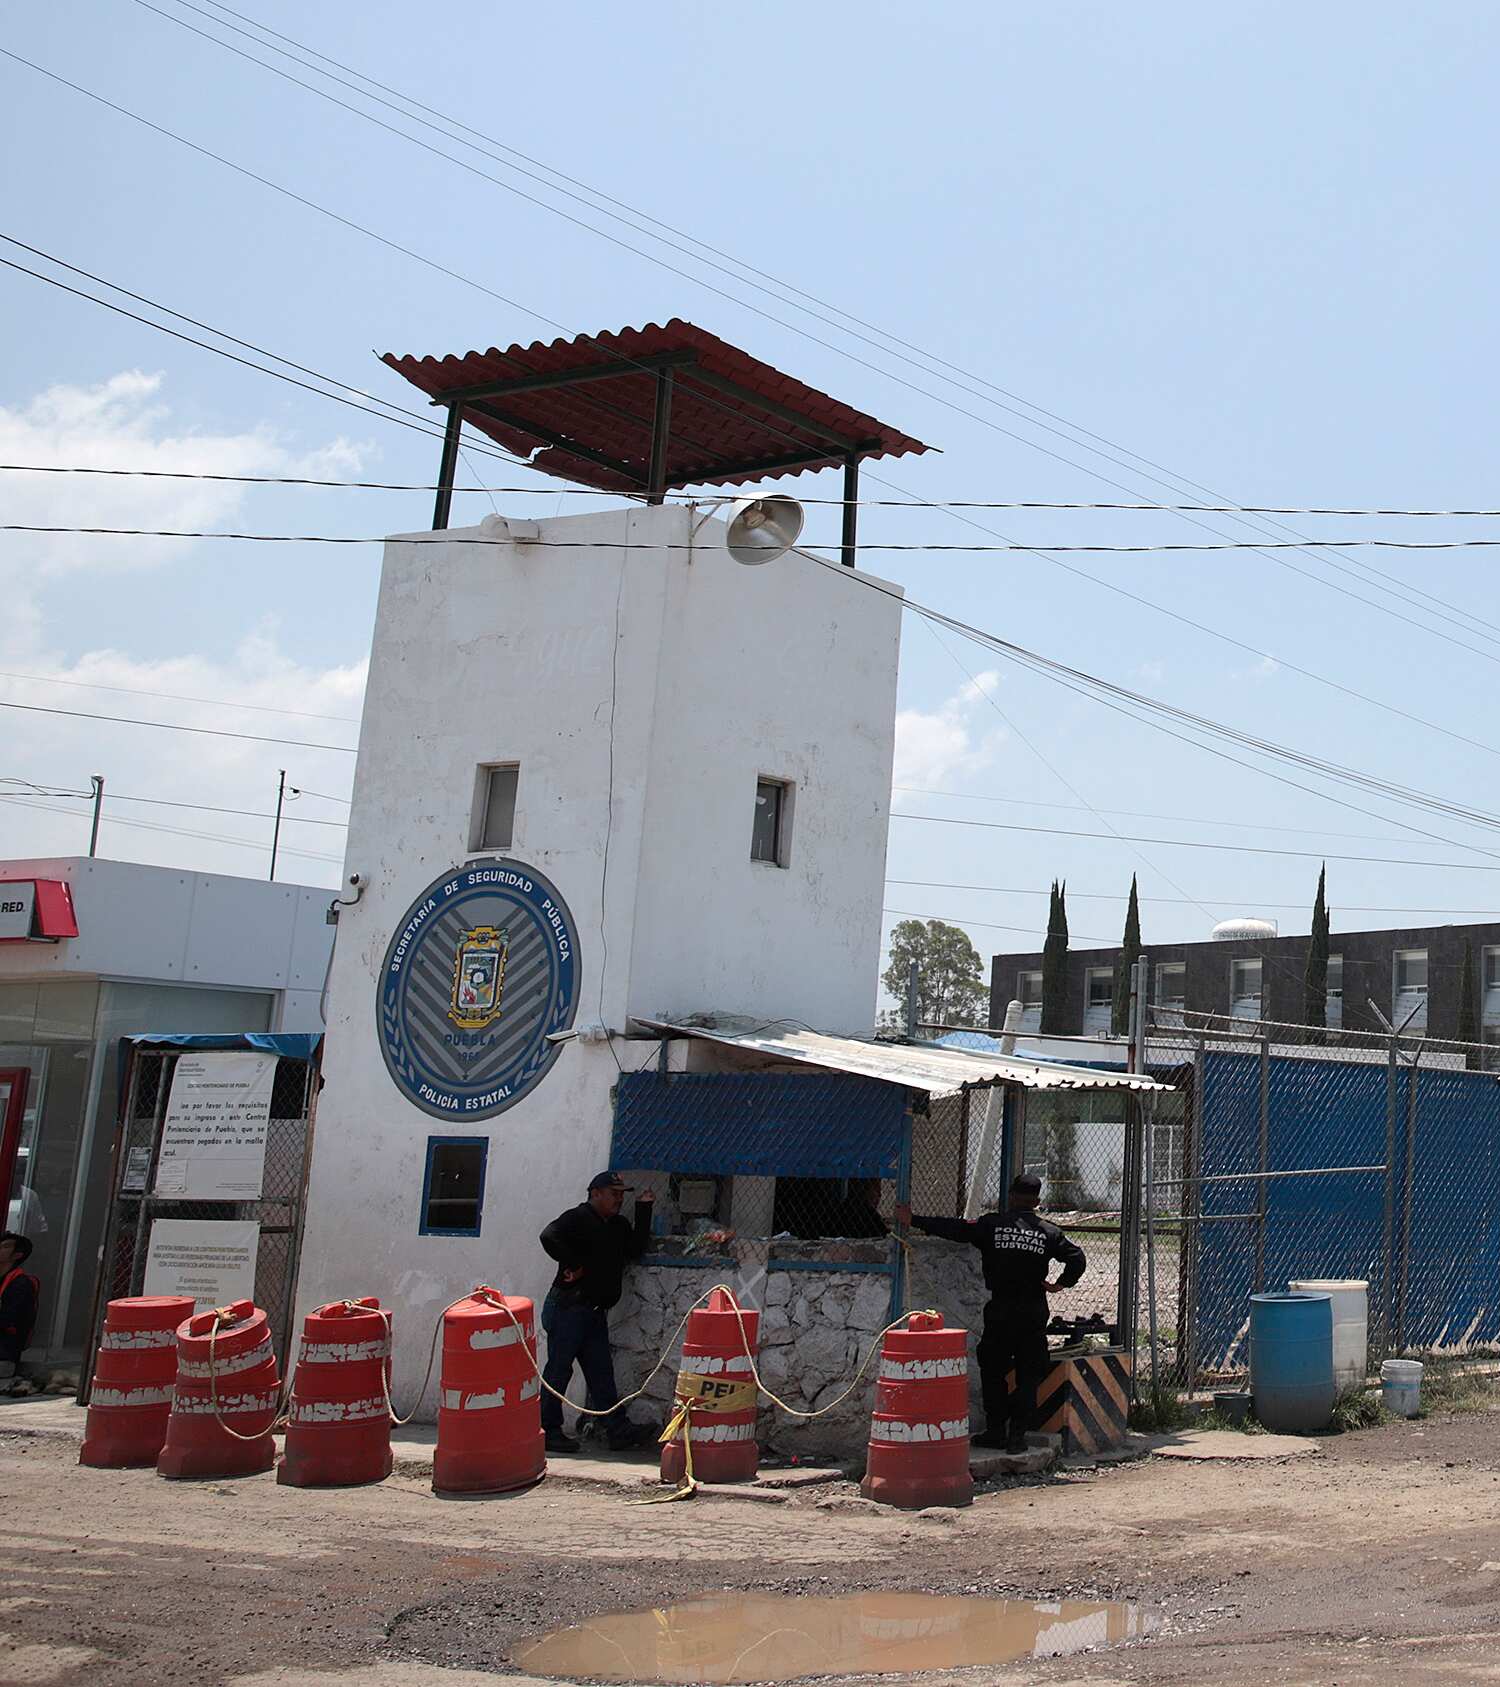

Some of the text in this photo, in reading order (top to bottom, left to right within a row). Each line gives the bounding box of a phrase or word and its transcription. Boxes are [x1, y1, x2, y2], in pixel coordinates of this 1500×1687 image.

[391, 871, 570, 972] SECRETARÍA DE SEGURIDAD PÚBLICA
[444, 1033, 497, 1046] PUEBLA
[419, 1084, 512, 1110] POLICÍA ESTATAL
[994, 1234, 1046, 1247] ESTATAL
